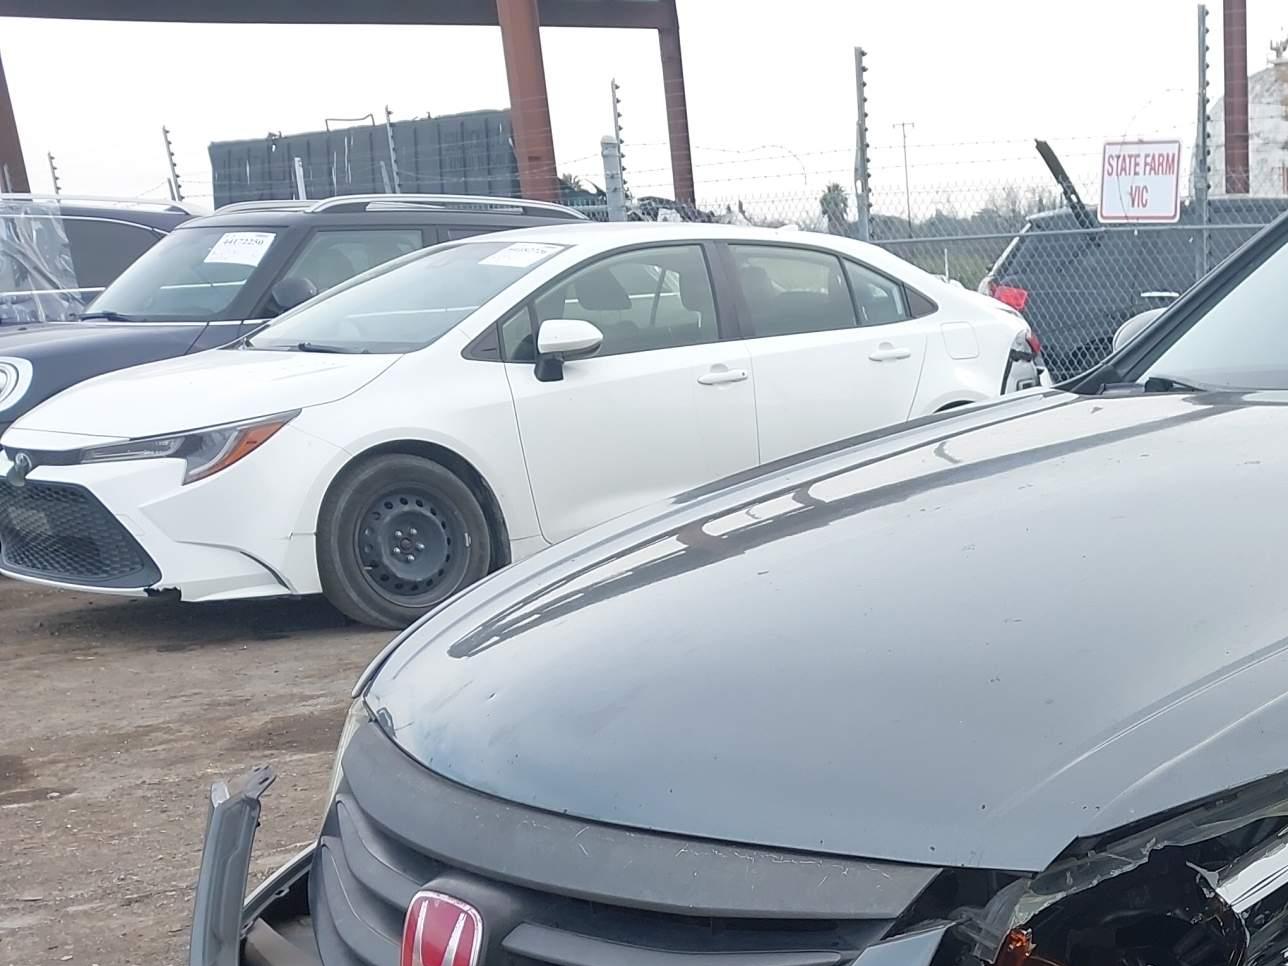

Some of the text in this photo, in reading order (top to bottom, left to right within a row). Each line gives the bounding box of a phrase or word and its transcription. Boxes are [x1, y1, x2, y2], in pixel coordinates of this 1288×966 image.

[1107, 152, 1175, 176] STATE FARM
[1129, 184, 1149, 208] VIC
